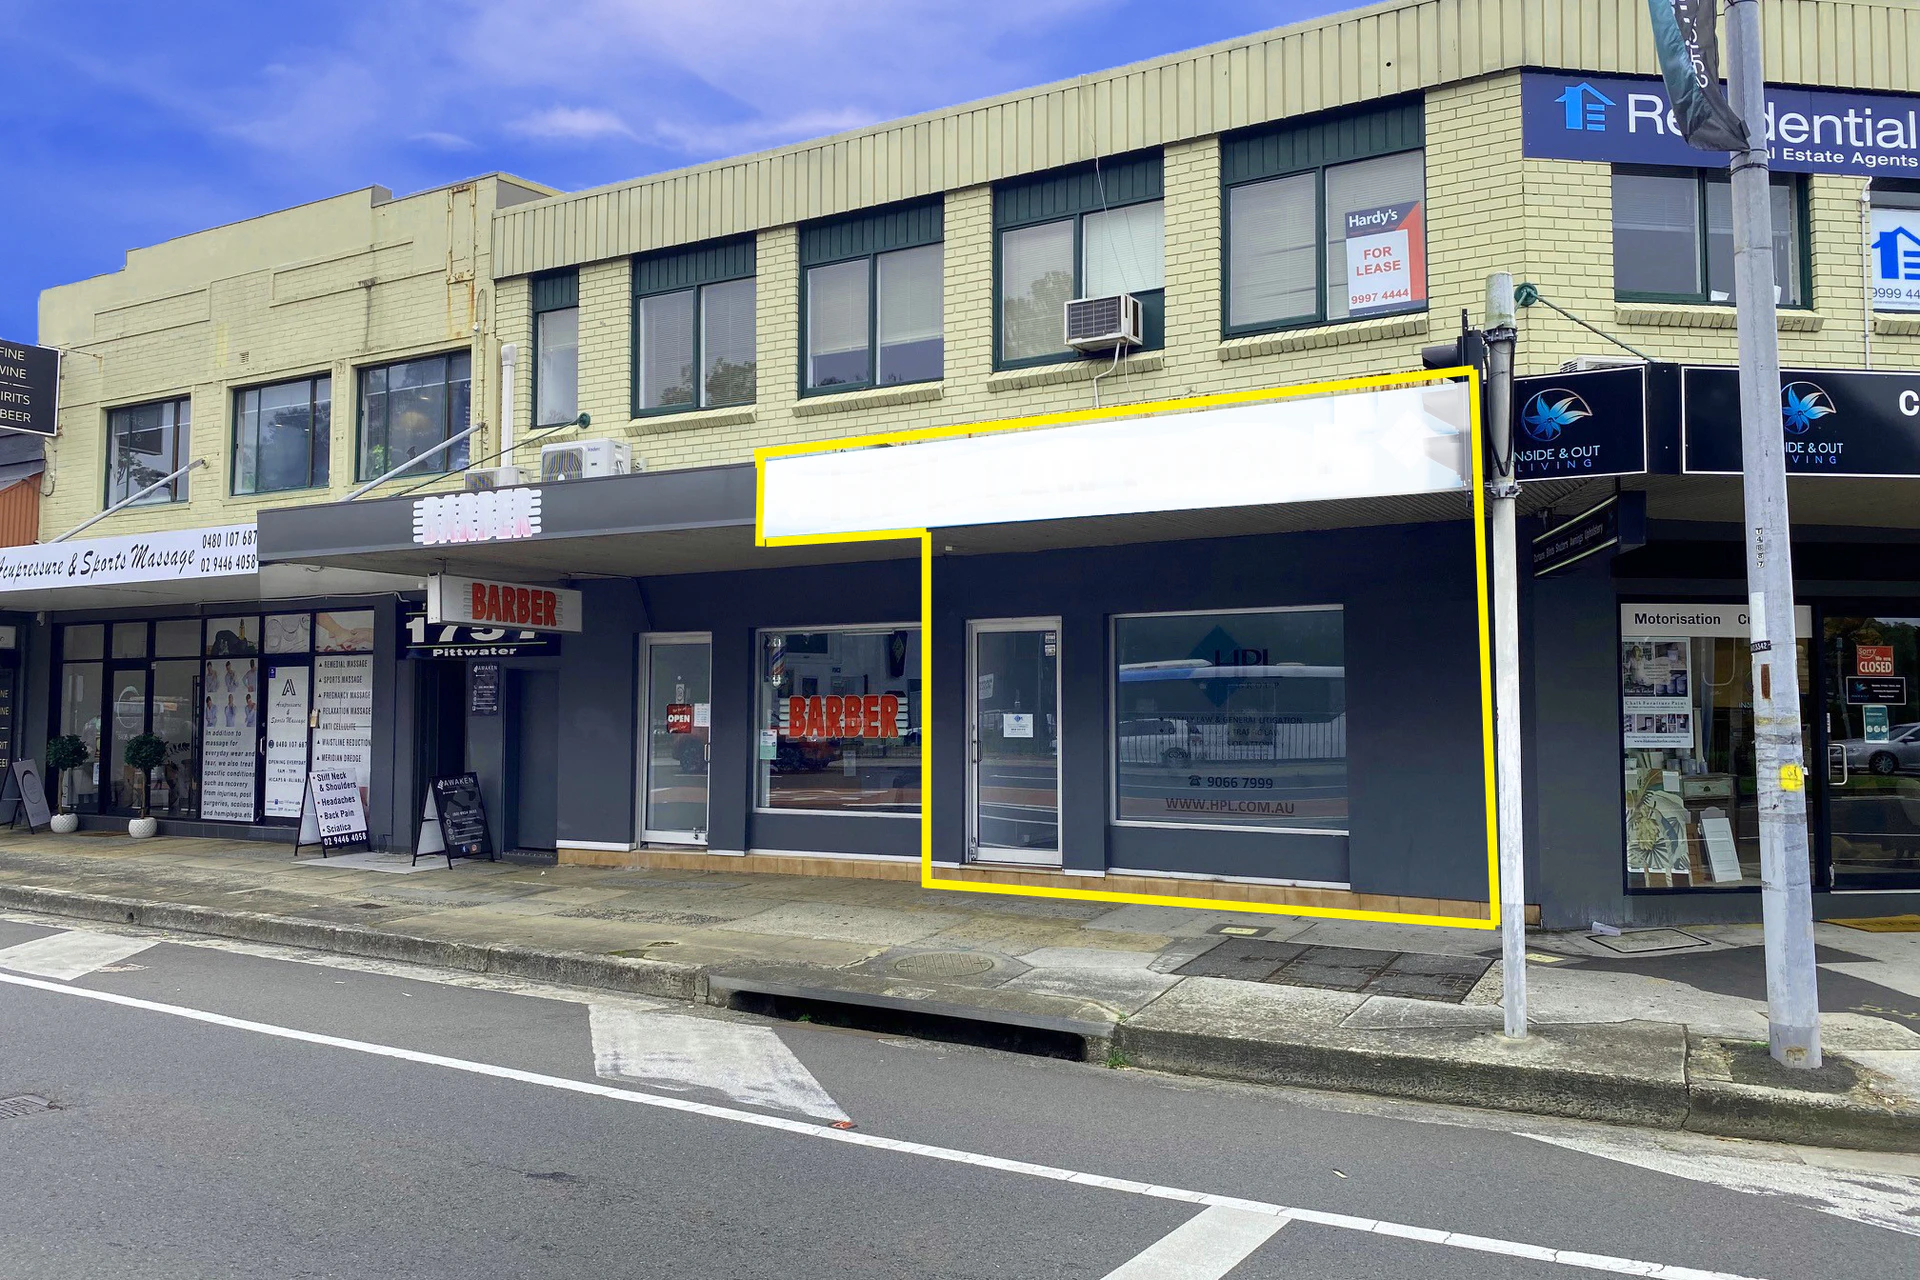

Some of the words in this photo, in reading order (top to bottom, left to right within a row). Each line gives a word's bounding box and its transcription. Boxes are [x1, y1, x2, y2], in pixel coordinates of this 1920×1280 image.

[1628, 93, 1917, 149] Redential
[1784, 147, 1845, 163] Estate
[1852, 151, 1919, 168] Agents
[1349, 209, 1398, 227] Hardy's
[1363, 246, 1392, 260] FOR
[1356, 260, 1402, 276] LEASE
[1351, 293, 1378, 304] 9997
[1382, 288, 1409, 300] 4444
[0, 391, 31, 405] IRITS
[0, 408, 31, 423] BEER
[1513, 448, 1555, 461] NSIDE
[1559, 447, 1569, 459] &
[1571, 444, 1601, 458] OUT
[1785, 442, 1805, 453] IDE
[1807, 442, 1817, 453] &
[1818, 442, 1844, 454] OUT
[1517, 459, 1593, 473] LIVING
[1791, 455, 1837, 464] VING
[202, 533, 222, 549] 0480
[225, 531, 240, 547] 107
[243, 530, 257, 546] 687
[68, 552, 78, 577] &
[80, 550, 126, 579] Sports
[131, 543, 195, 574] Massage
[201, 558, 210, 572] 02
[213, 555, 233, 571] 9446
[235, 554, 256, 570] 4058
[472, 582, 557, 627] BARBER
[1634, 613, 1721, 625] Motorisation
[432, 647, 517, 657] Pittwater
[1858, 648, 1877, 657] Sorry
[324, 660, 345, 668] REMEDIAL
[346, 660, 368, 668] MASSAGE
[1860, 661, 1892, 673] CLOSED
[323, 676, 341, 684] SPORTS
[341, 675, 362, 683] MASSAGE
[350, 691, 371, 699] MASSAGE
[322, 707, 349, 715] RELAXATION
[350, 707, 371, 715] MASSAGE
[788, 694, 900, 738] BARBER
[668, 714, 690, 722] OPEN
[331, 772, 347, 780] Neck
[444, 777, 474, 787] AWAKEN
[1207, 776, 1238, 788] 9066
[1242, 777, 1274, 789] 7999
[320, 784, 324, 792] &
[326, 782, 357, 791] Shoulders
[321, 796, 356, 806] Headaches
[1166, 797, 1295, 814] WWW.HPL.COM.AU
[324, 810, 339, 820] Back
[340, 810, 355, 818] Pain
[326, 824, 352, 833] Sciatica
[323, 838, 332, 846] 02
[333, 835, 350, 845] 9446
[351, 832, 367, 842] 4058
